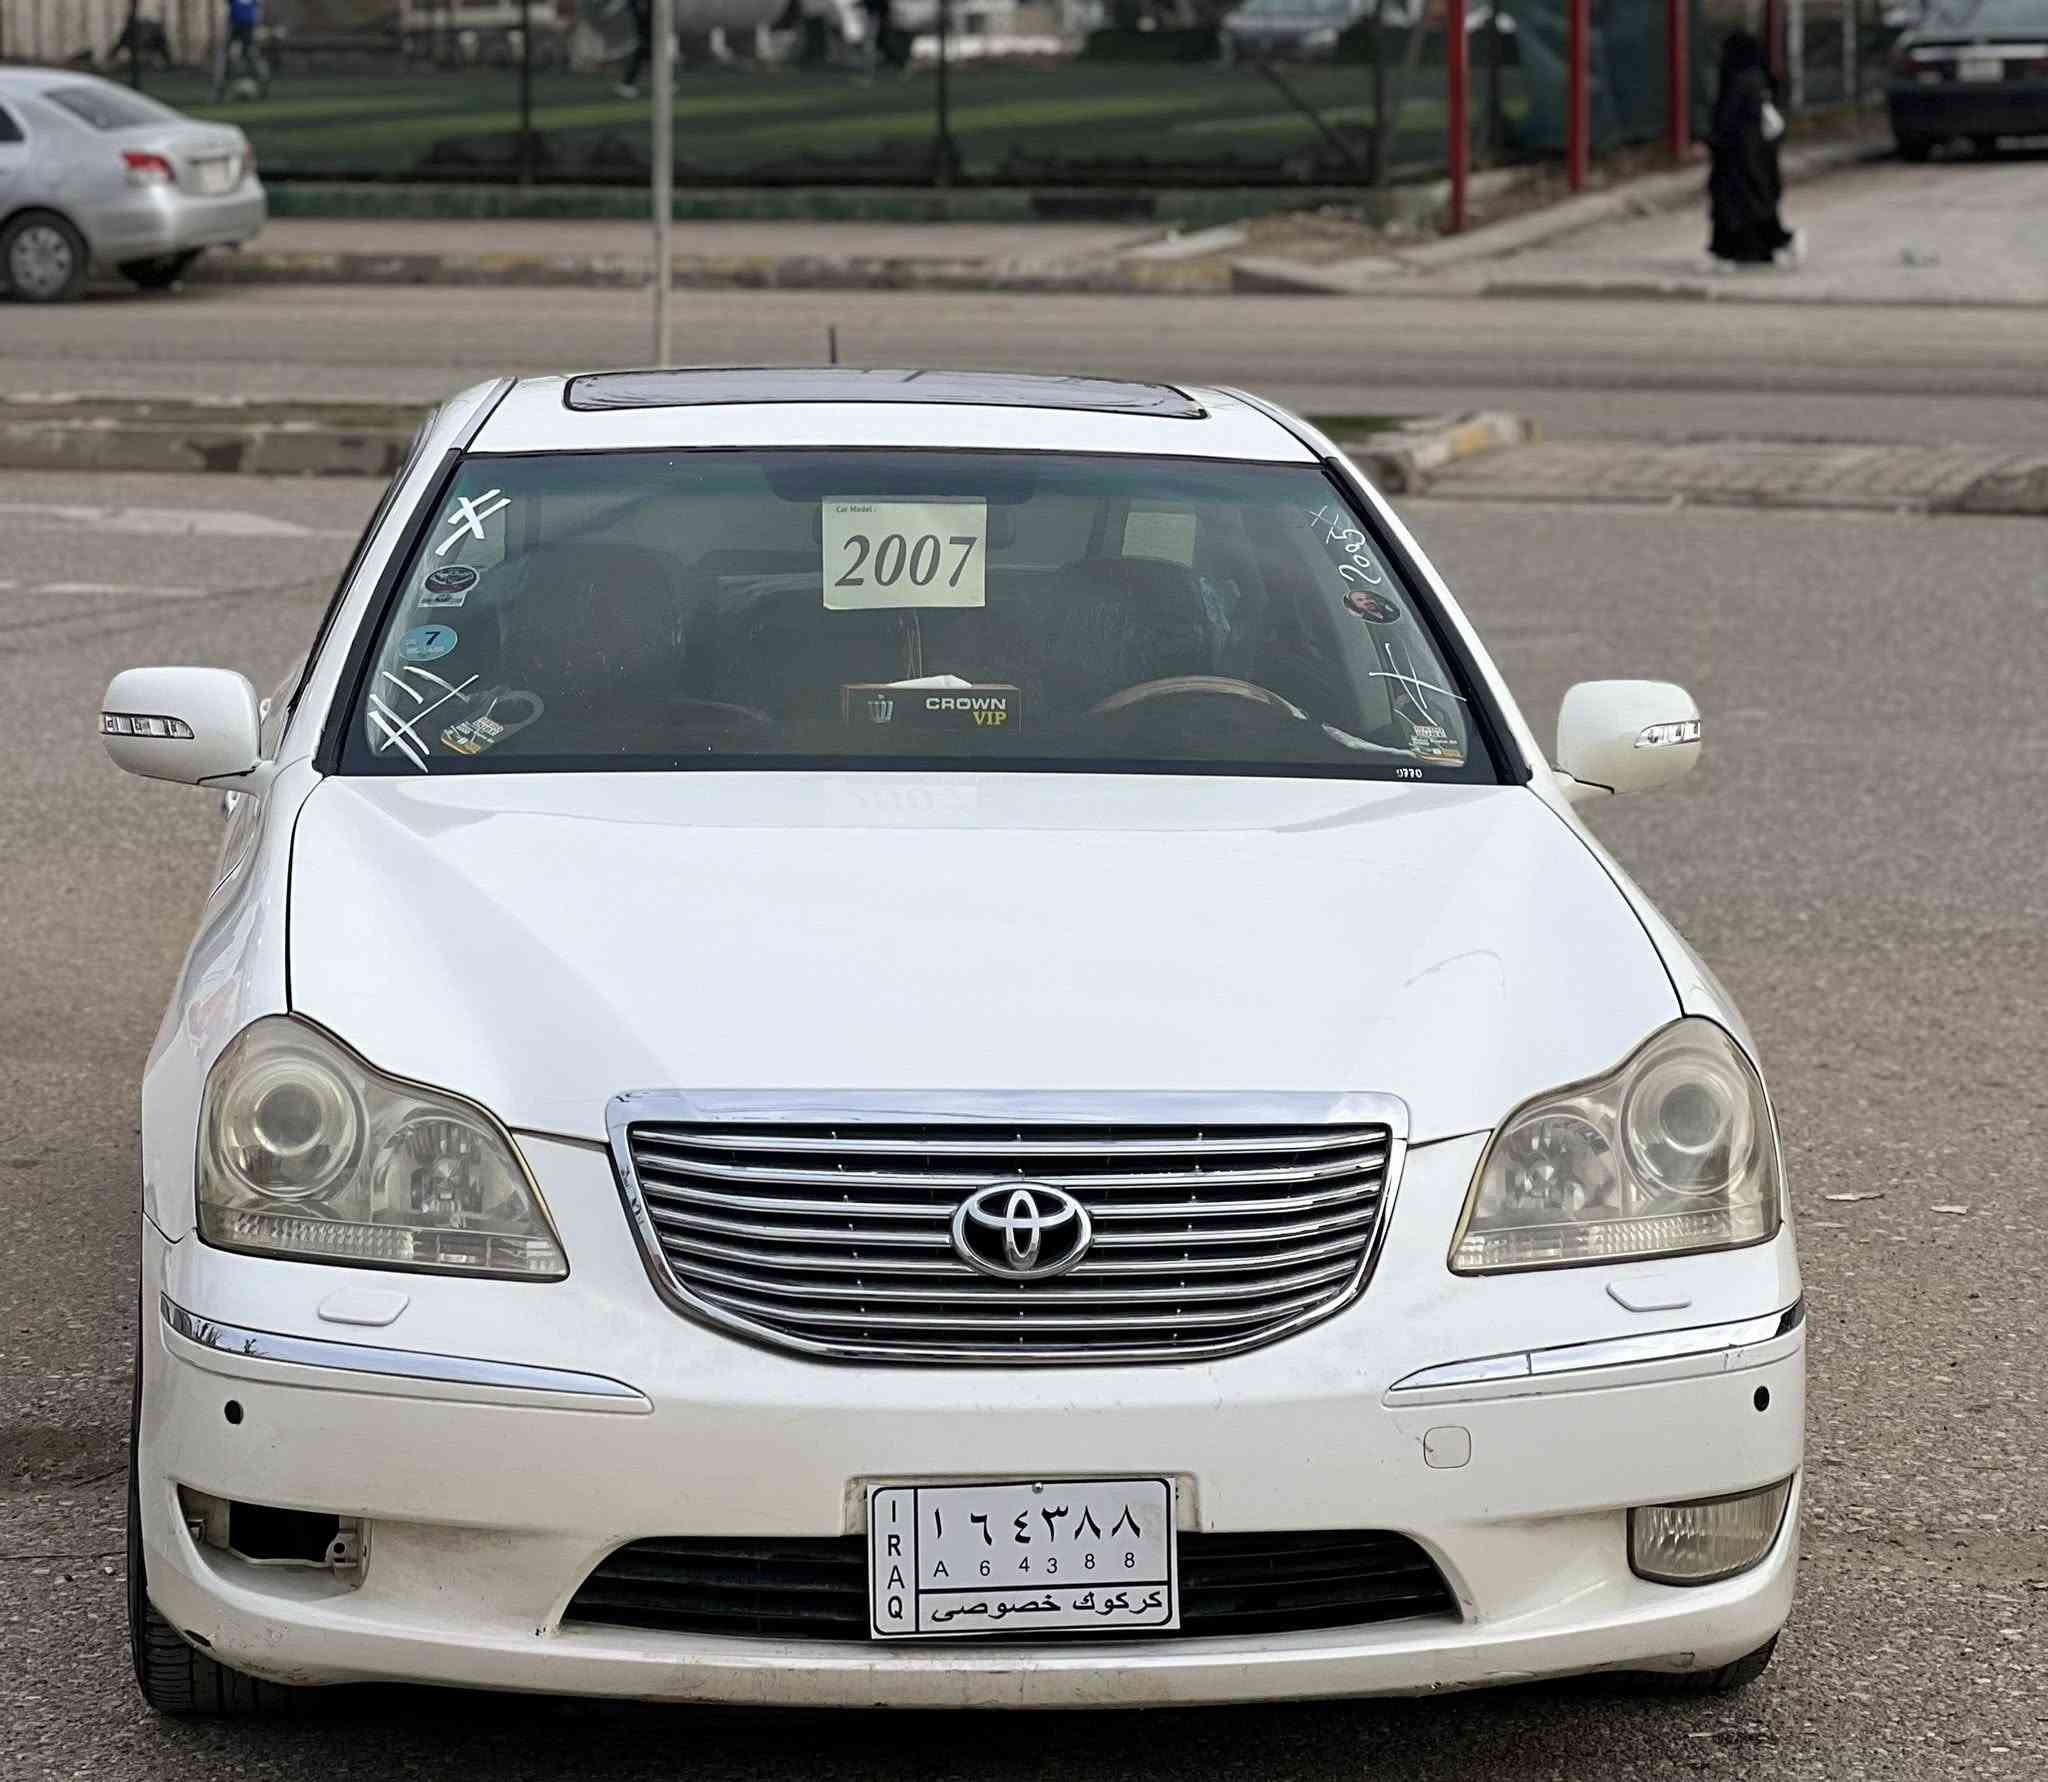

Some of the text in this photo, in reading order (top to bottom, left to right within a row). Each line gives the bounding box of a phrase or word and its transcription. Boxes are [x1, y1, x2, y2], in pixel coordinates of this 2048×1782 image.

[834, 533, 978, 588] 2007
[425, 631, 441, 646] 7
[925, 697, 1007, 711] CROWN
[973, 711, 1007, 726] VIP
[887, 1499, 905, 1620] IRAQ
